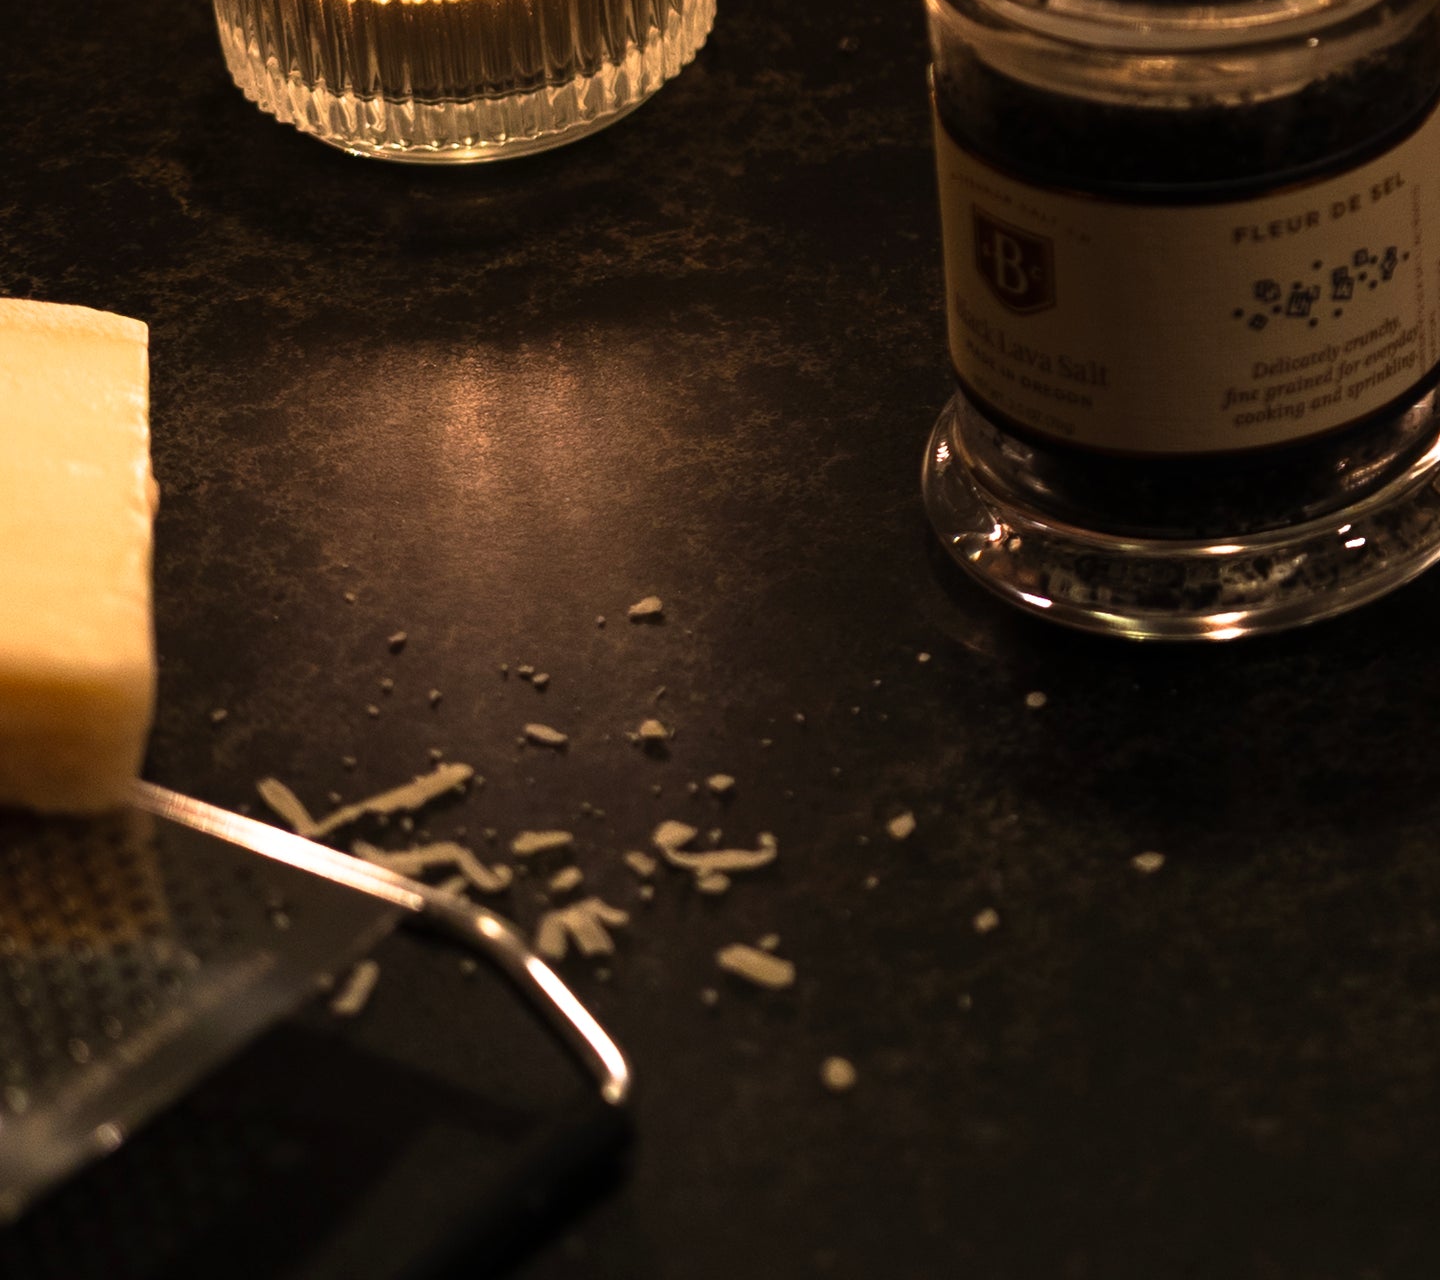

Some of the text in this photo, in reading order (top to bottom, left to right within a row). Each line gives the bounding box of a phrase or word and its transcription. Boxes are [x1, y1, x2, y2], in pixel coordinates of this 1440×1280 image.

[1232, 173, 1406, 244] FLEUR DE SEL
[999, 331, 1053, 373] Lava
[1057, 353, 1109, 388] Salt
[1222, 385, 1260, 412] fine
[1264, 364, 1334, 402] grained
[1233, 397, 1306, 428] cooking
[1309, 385, 1342, 411] and
